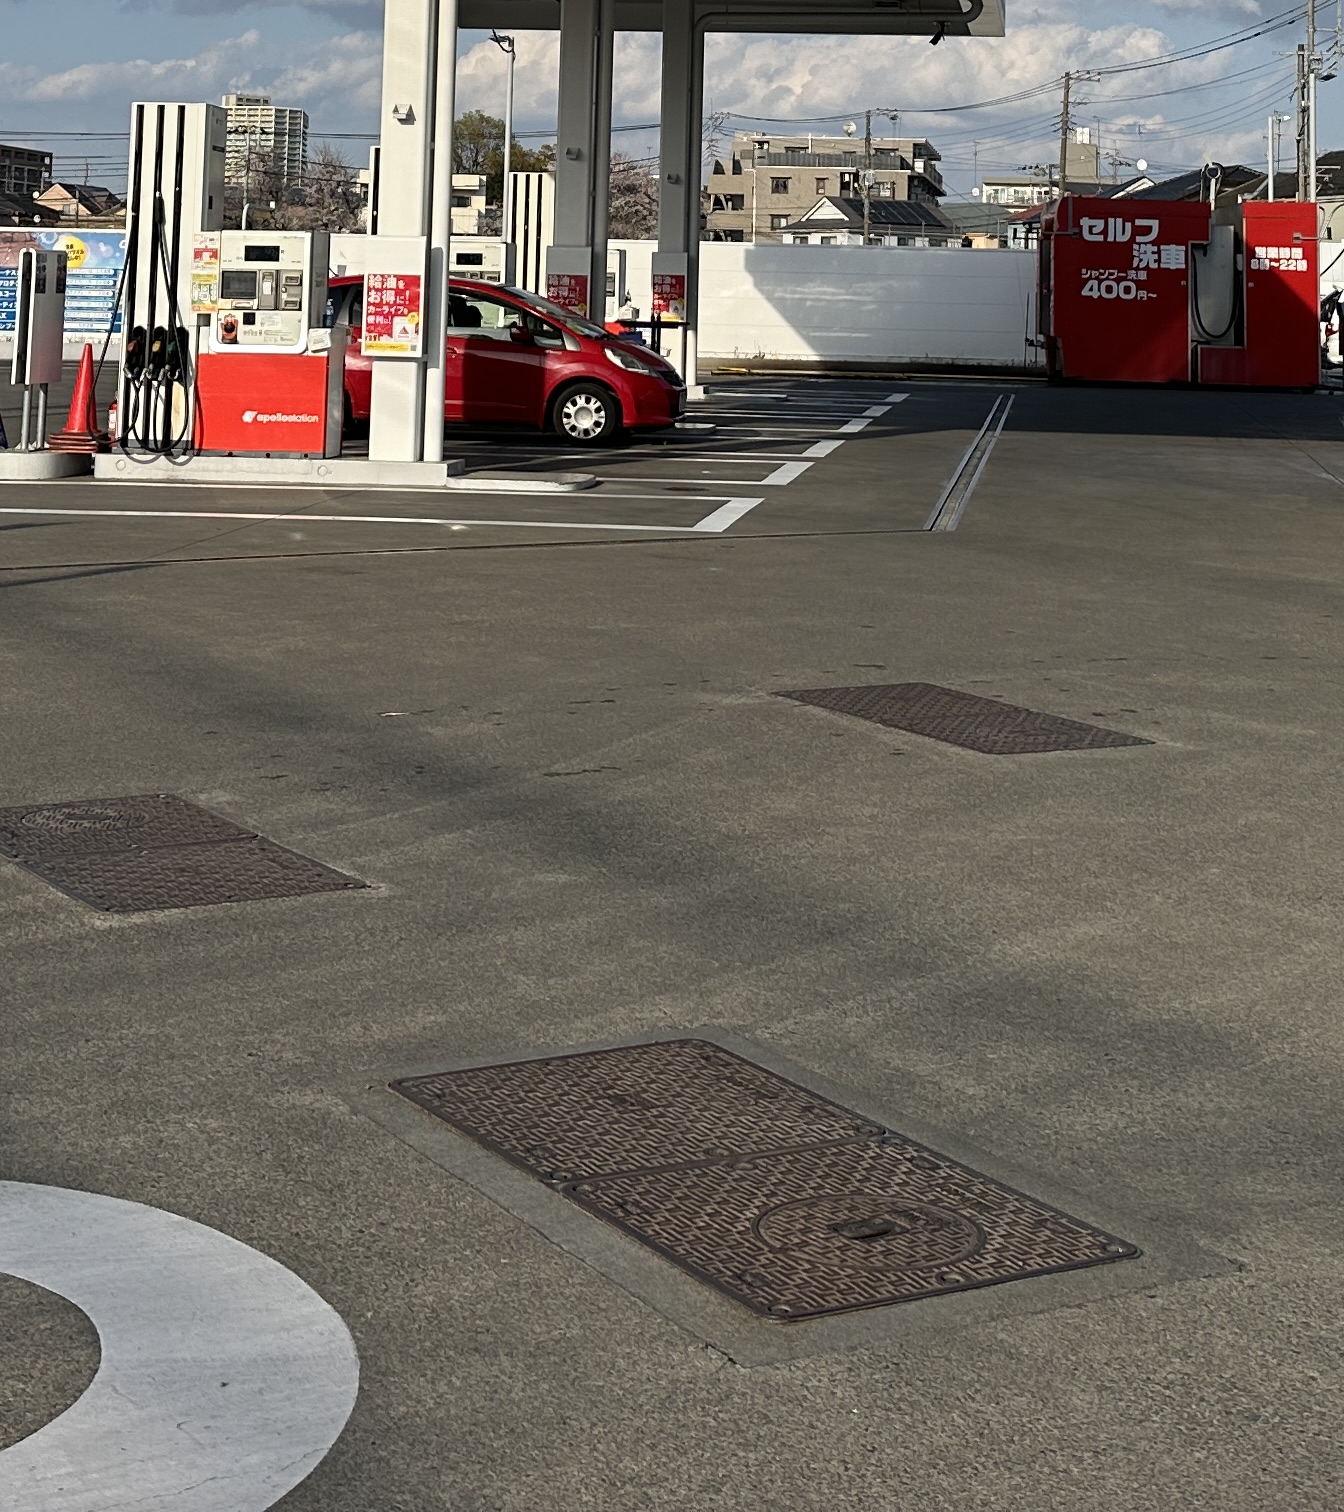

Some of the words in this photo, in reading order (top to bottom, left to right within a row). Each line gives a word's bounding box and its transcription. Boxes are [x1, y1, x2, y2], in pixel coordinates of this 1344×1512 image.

[1080, 217, 1160, 243] セルフ
[1132, 244, 1186, 269] 洗車
[1081, 269, 1147, 281] シャンプー洗車
